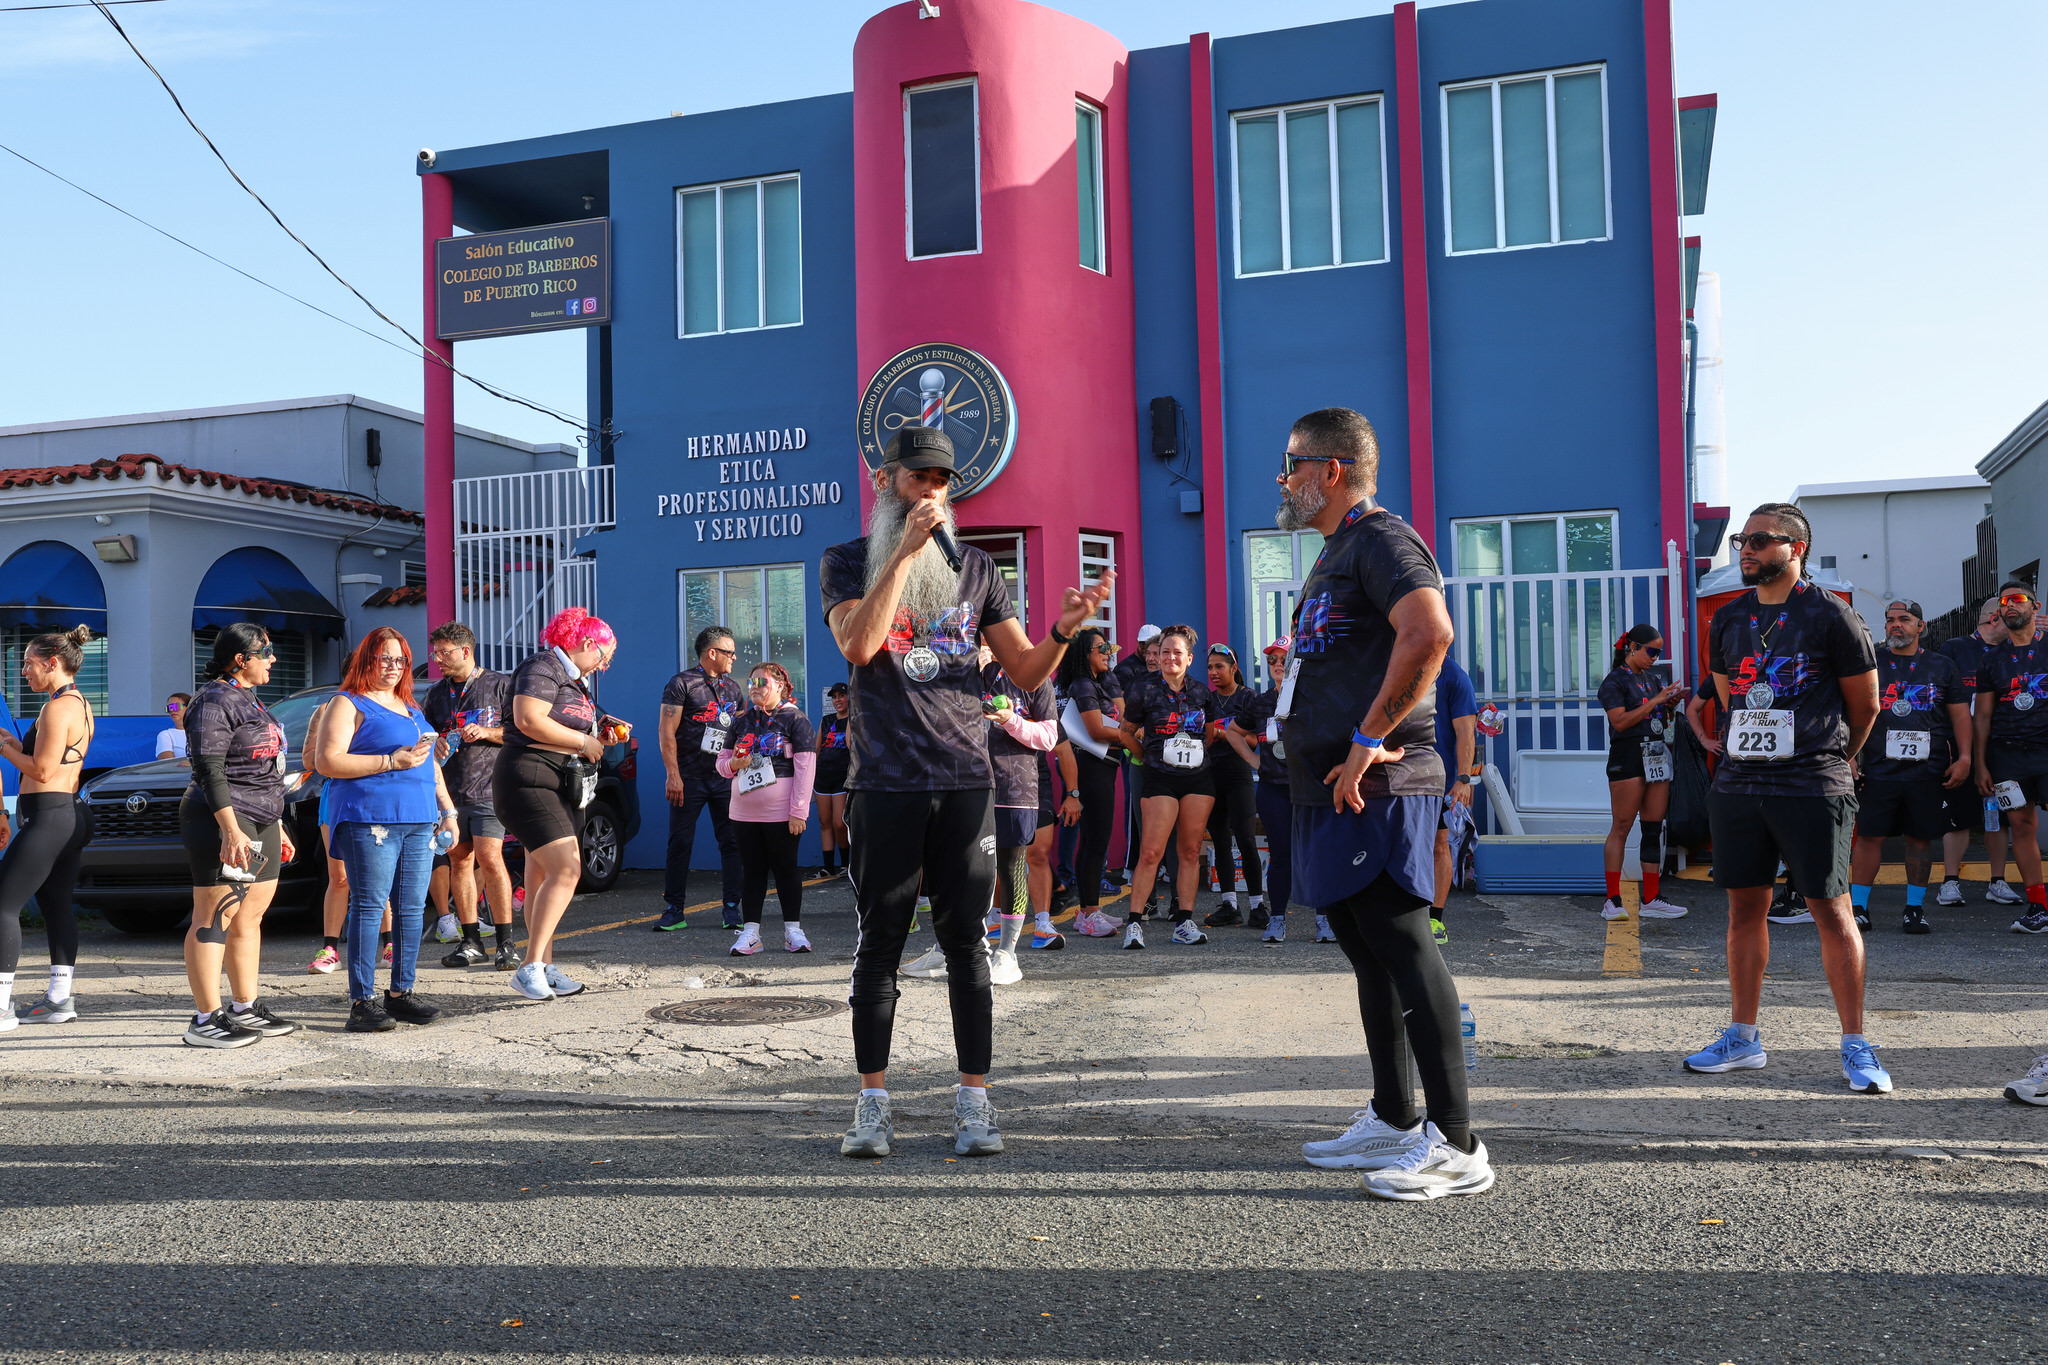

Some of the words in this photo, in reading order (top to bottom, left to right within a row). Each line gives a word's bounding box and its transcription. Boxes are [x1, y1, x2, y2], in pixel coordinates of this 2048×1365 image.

[465, 242, 503, 260] Salón
[507, 235, 575, 255] Educativo
[443, 265, 502, 284] COLEGIO
[505, 263, 524, 278] DE
[527, 254, 598, 275] BARBEROS
[463, 289, 482, 304] DE
[485, 282, 539, 302] PUERTO
[542, 278, 577, 294] RICO
[530, 309, 556, 318] Búscanos
[863, 395, 878, 435] COLEGIO
[875, 380, 886, 394] DE
[883, 352, 924, 383] BARBEROS
[924, 351, 931, 359] Y
[931, 350, 977, 370] ESTILISTAS
[974, 367, 986, 380] EN
[982, 377, 1003, 423] BARBERÍA
[959, 410, 980, 419] 1989
[687, 427, 807, 459] HERMANDAD
[719, 458, 776, 484] ETICA
[657, 481, 842, 516] PROFESIONALISMO
[694, 519, 706, 542] Y
[711, 513, 802, 541] SERVICIO
[1746, 711, 1770, 720] FADE
[1757, 719, 1779, 727] RUN
[710, 740, 723, 752] 13
[1738, 732, 1777, 752] 223
[1900, 743, 1918, 756] 73
[252, 746, 280, 760] FADE
[1176, 751, 1191, 764] 11
[747, 772, 764, 787] 33
[1649, 766, 1664, 779] 215
